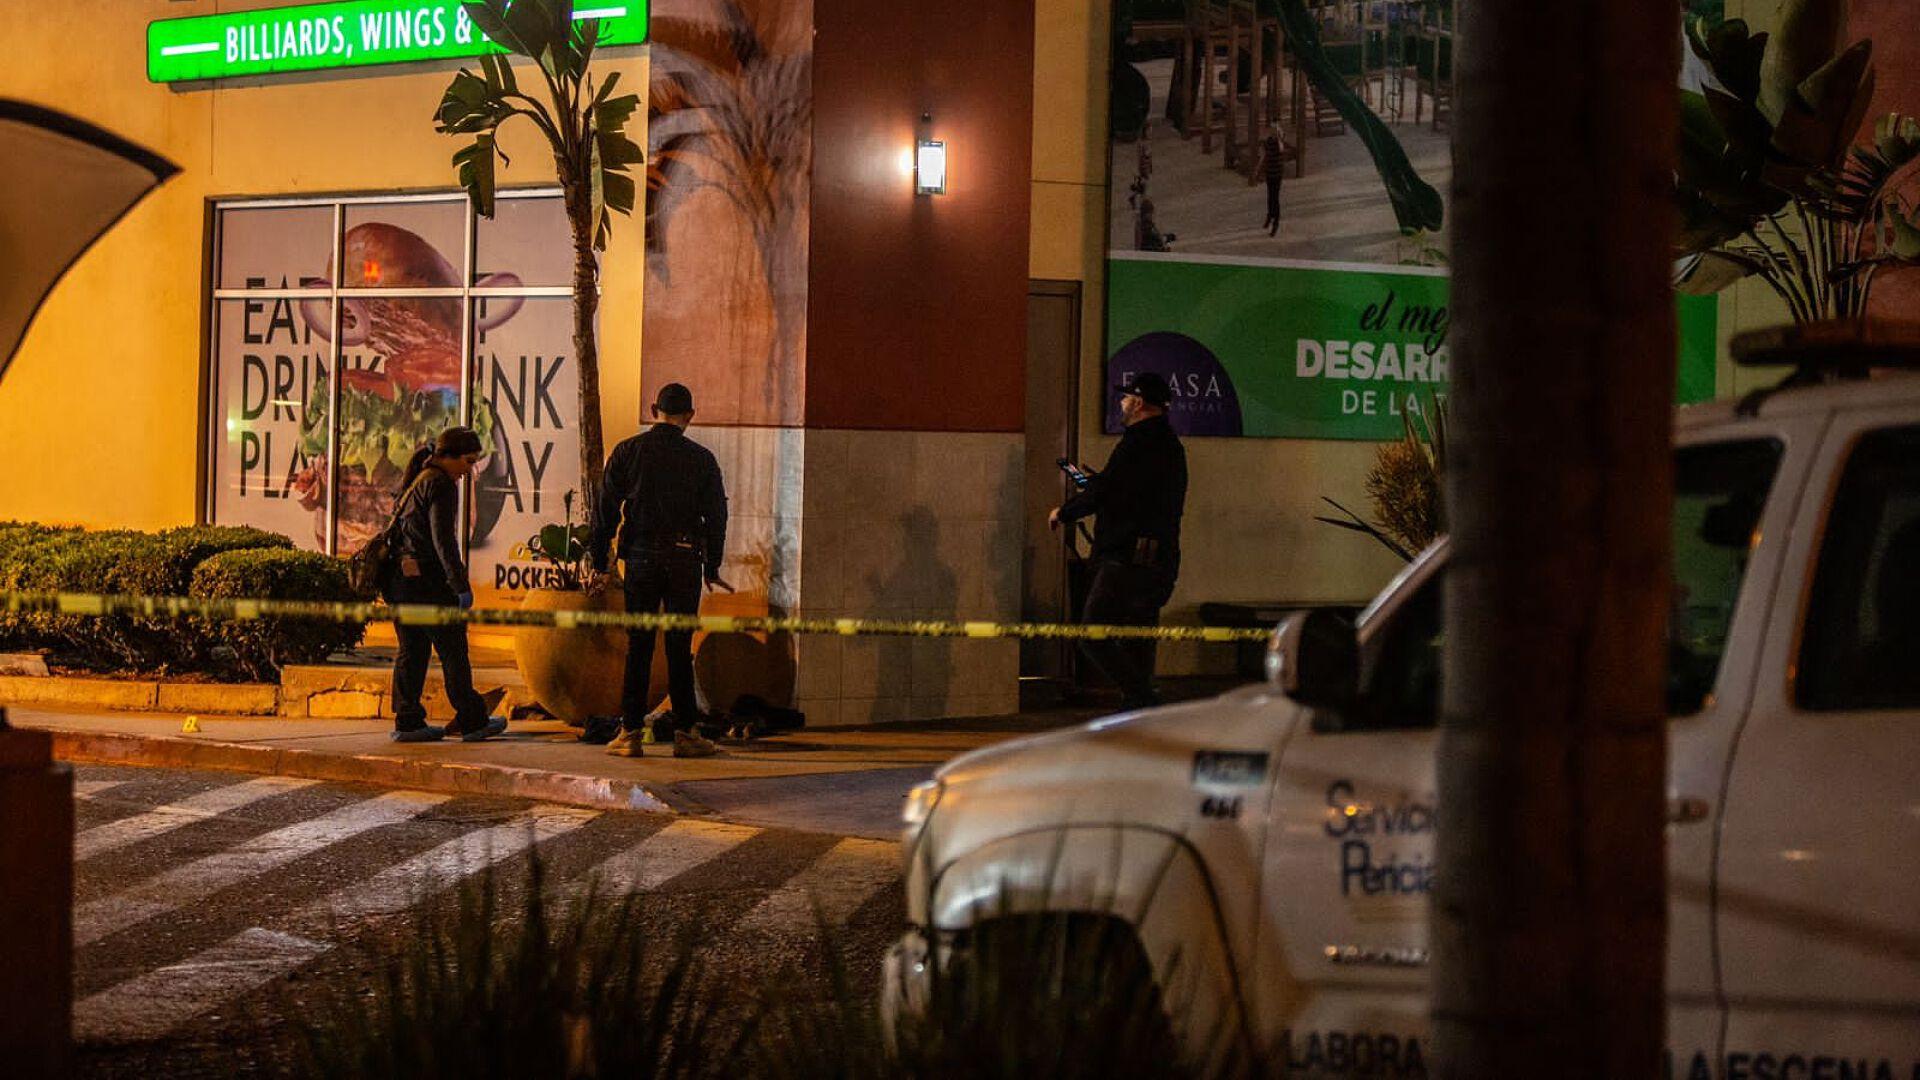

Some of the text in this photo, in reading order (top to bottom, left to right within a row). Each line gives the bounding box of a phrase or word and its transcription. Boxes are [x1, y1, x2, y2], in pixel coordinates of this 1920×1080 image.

[226, 5, 472, 63] BILLIARDS, WINGS &
[1361, 289, 1395, 331] el
[1296, 337, 1450, 383] DESARR
[1342, 389, 1421, 416] DE LA
[1282, 1029, 1427, 1075] LABORA
